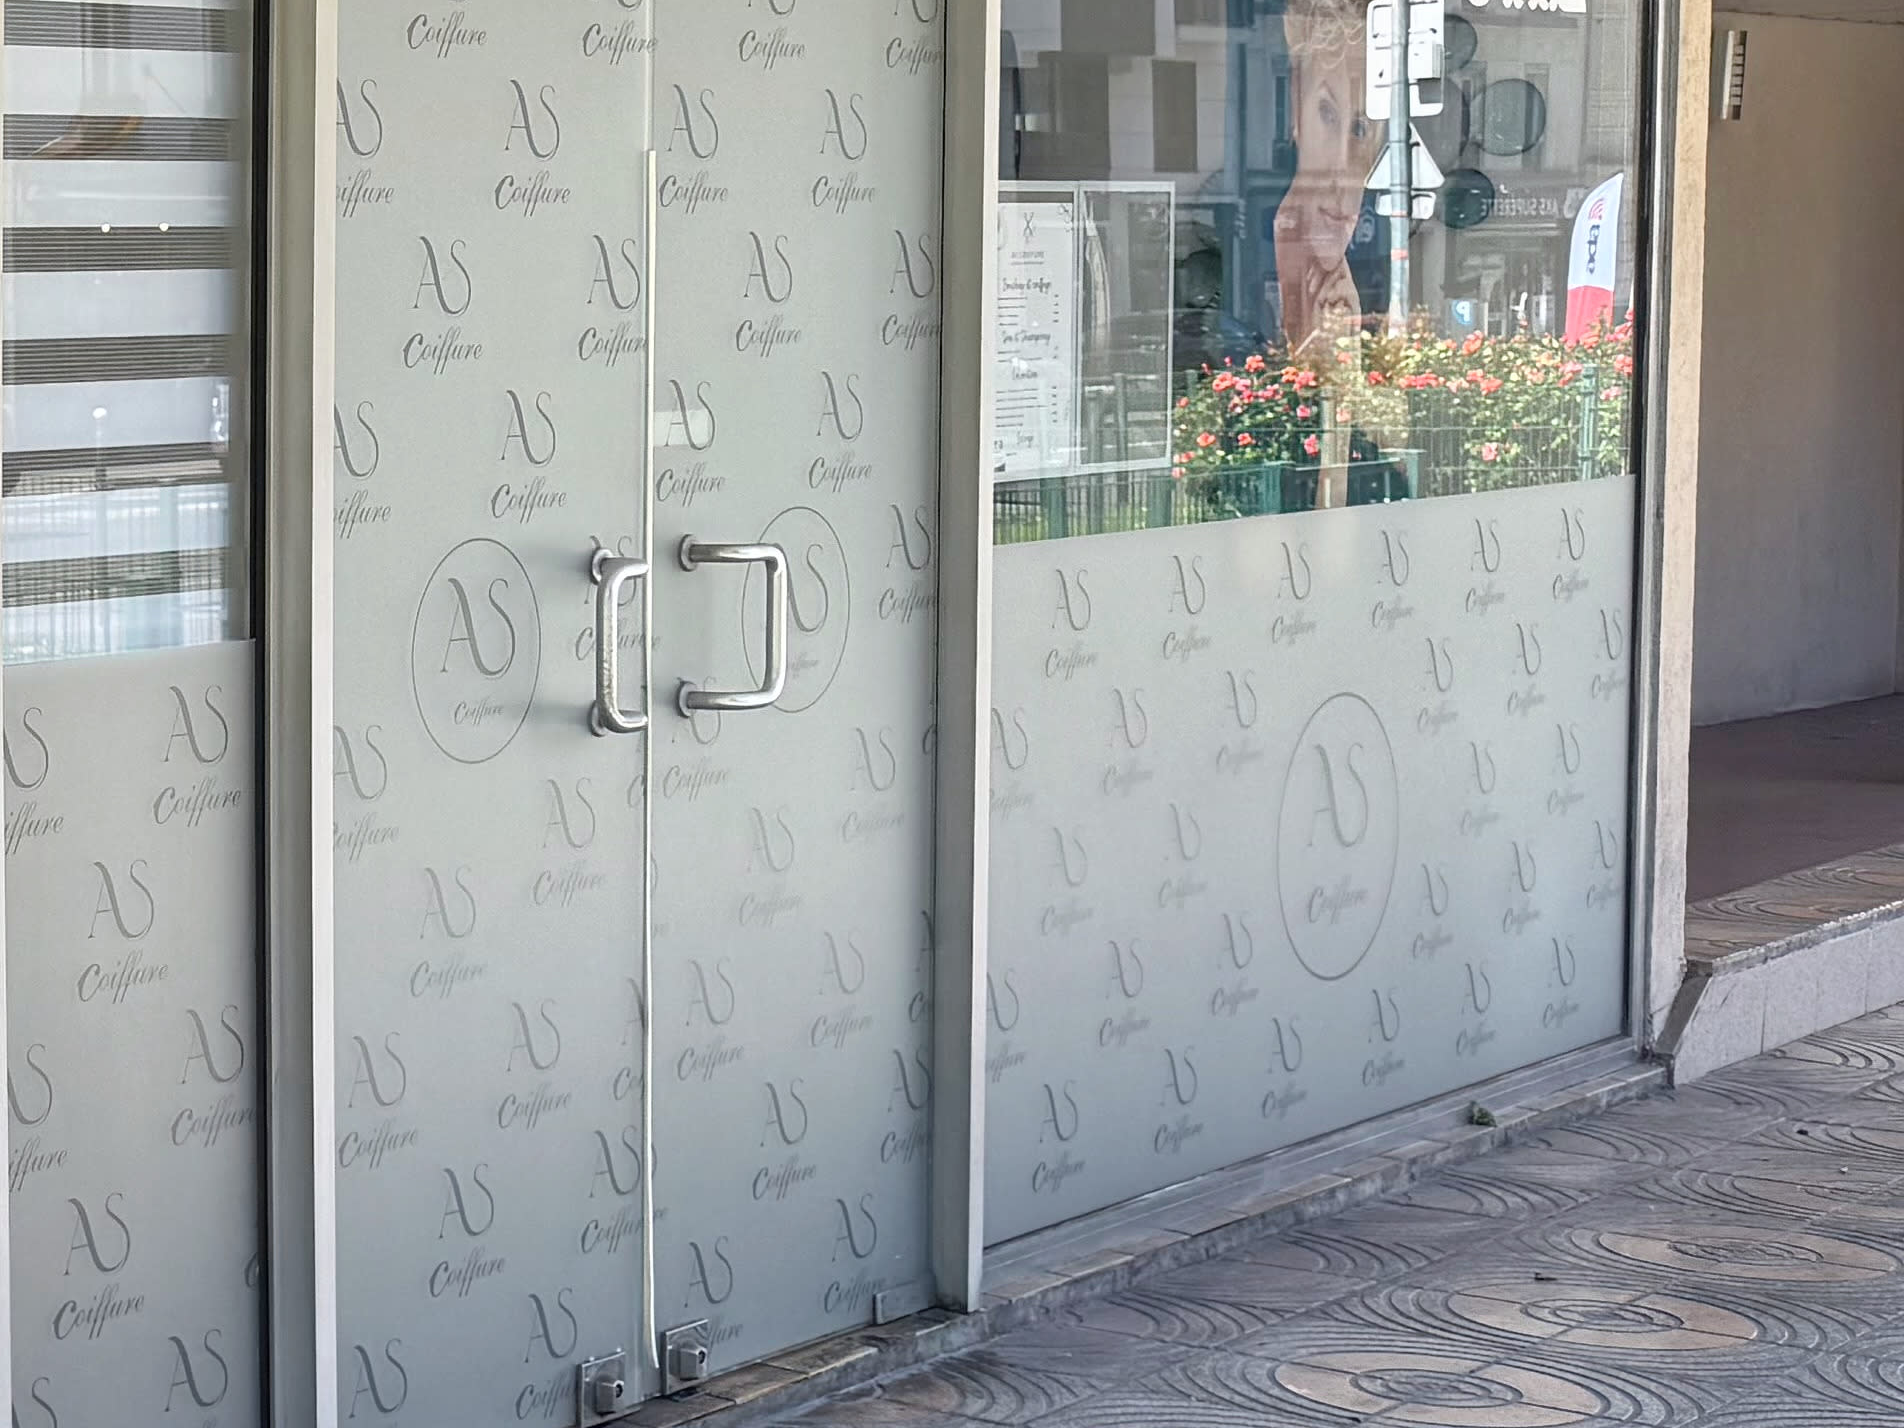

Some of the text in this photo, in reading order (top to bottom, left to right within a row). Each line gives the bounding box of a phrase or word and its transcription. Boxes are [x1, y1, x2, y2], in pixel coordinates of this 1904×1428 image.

[406, 11, 487, 59] Coiffure
[738, 28, 805, 70] Coiffure
[504, 79, 560, 160] AS
[819, 88, 867, 161] AS
[494, 171, 571, 217] Coiffure
[811, 173, 876, 214] Coiffure
[413, 235, 472, 316] AS
[743, 231, 793, 304] AS
[402, 327, 482, 375] Coiffure
[734, 315, 801, 358] Coiffure
[500, 389, 556, 466] AS
[816, 371, 863, 441] AS
[490, 477, 567, 523] Coiffure
[808, 453, 872, 493] Coiffure
[439, 577, 516, 679] AS
[161, 685, 228, 764] AS
[5, 802, 64, 855] iffure
[153, 775, 242, 828] Coiffure
[88, 860, 154, 939] AS
[77, 949, 169, 1005] Coiffure
[182, 1004, 244, 1084] AS
[171, 1095, 256, 1149] Coiffur
[9, 1137, 68, 1193] iffure
[63, 1192, 131, 1276] AS
[52, 1283, 145, 1341] Coiffure
[164, 1328, 229, 1412] AS
